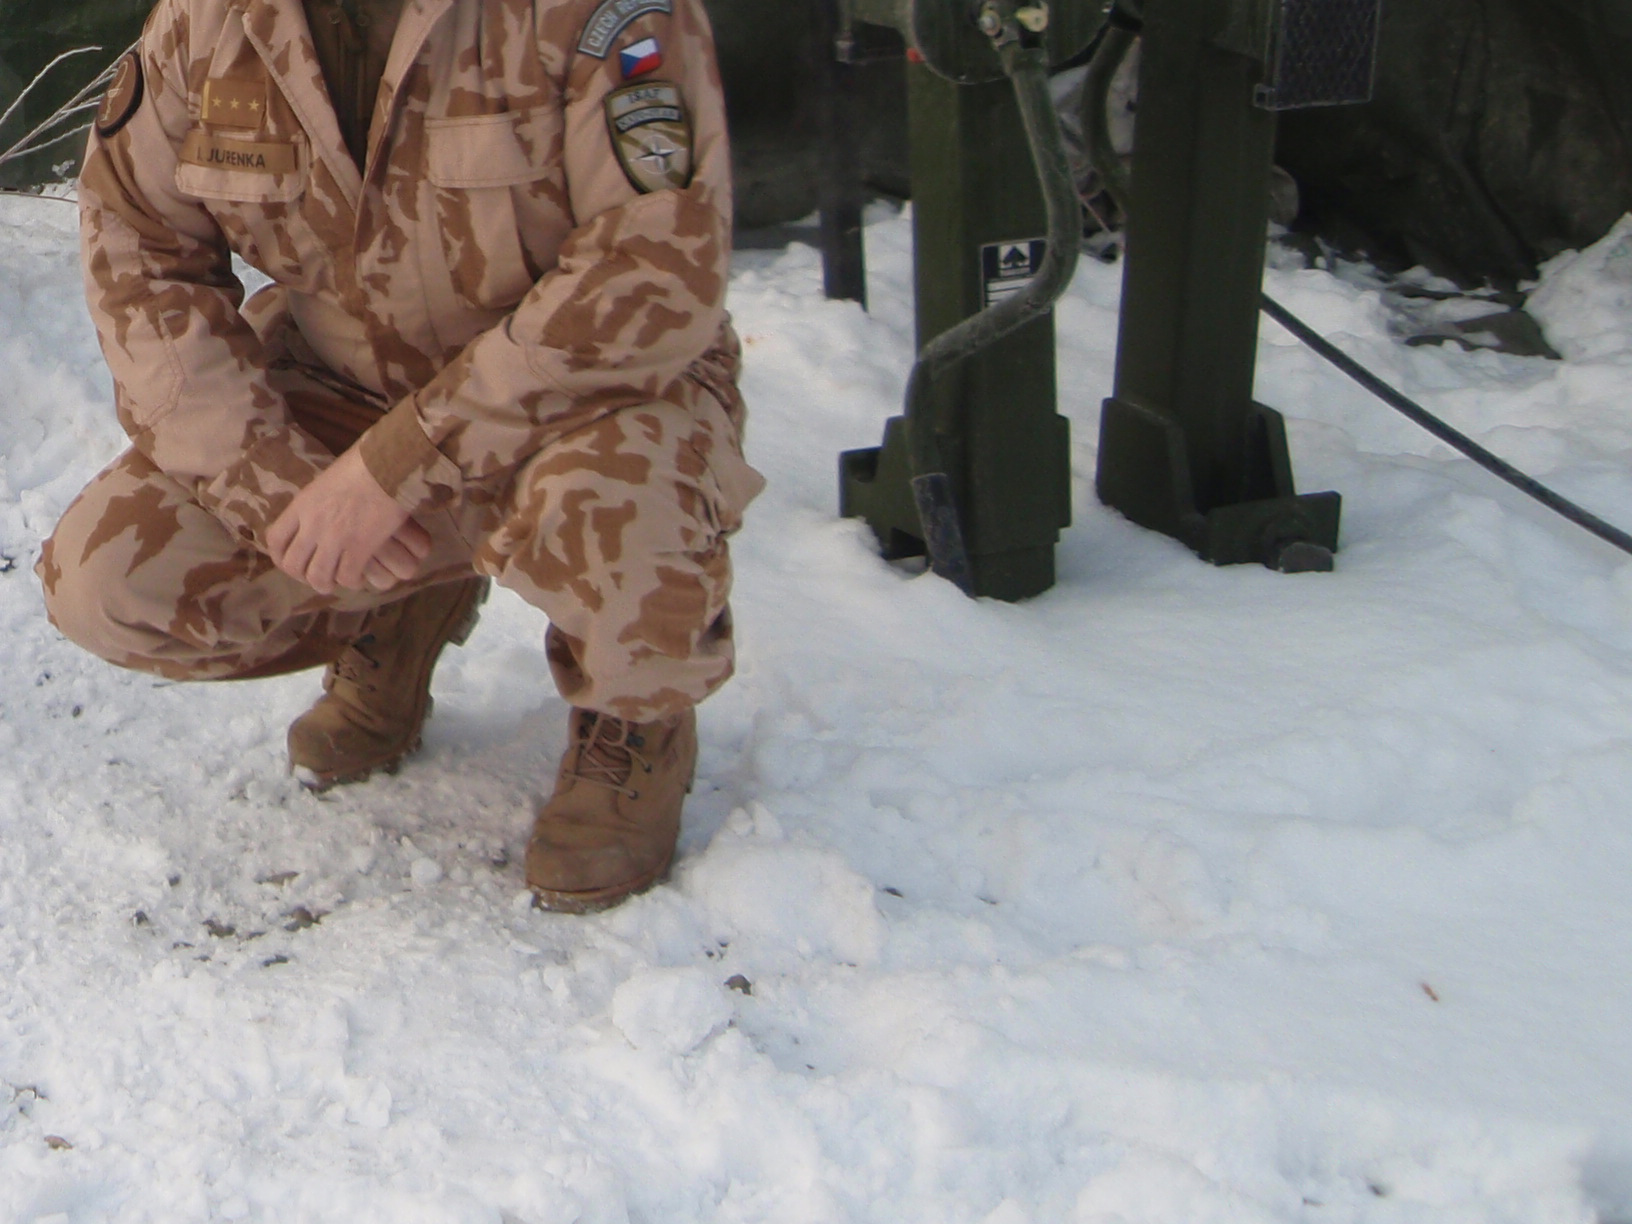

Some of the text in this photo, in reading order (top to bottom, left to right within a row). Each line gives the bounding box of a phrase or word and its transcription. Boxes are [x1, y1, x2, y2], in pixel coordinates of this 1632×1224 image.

[587, 10, 619, 47] CZECH
[628, 88, 661, 104] ISAF
[207, 147, 266, 169] JURENKA
